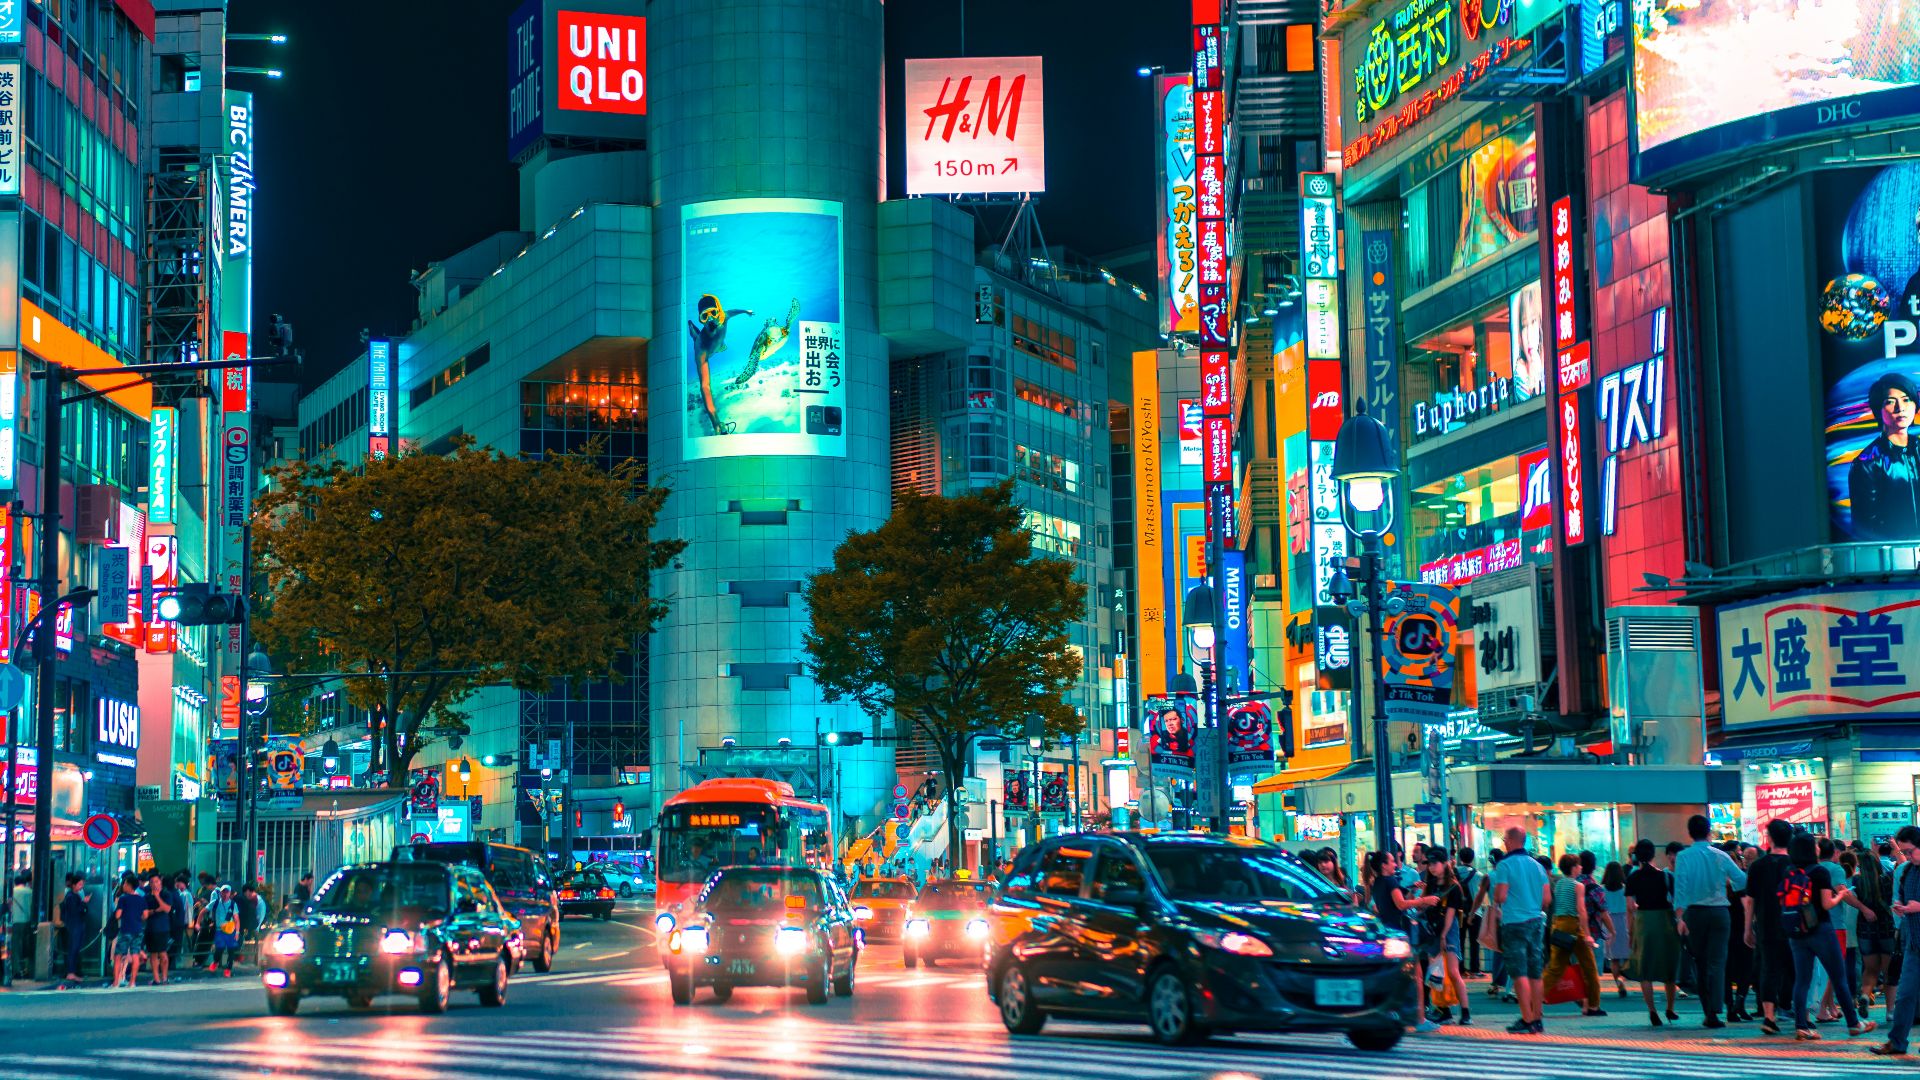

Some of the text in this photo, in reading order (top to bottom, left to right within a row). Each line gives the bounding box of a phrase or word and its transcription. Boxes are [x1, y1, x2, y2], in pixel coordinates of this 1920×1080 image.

[517, 15, 534, 77] THE
[570, 25, 636, 62] UNI
[1397, 1, 1451, 93] 西村
[511, 66, 540, 139] PRIME
[570, 65, 643, 105] QLO
[923, 74, 1026, 143] H&M
[1817, 100, 1861, 124] DHC
[230, 105, 256, 257] BIC CAMERA
[1205, 157, 1215, 165] 7F
[1206, 222, 1216, 230] 7F
[1207, 287, 1219, 295] 6F
[1317, 284, 1328, 344] Euphoria
[805, 336, 840, 351] 世界に
[1209, 355, 1220, 363] 6F
[1369, 289, 1394, 453] サマーフルー
[1313, 391, 1339, 410] JTB
[1415, 371, 1509, 435] Euphoria
[1600, 355, 1664, 453] クスリ
[1210, 421, 1222, 429] 6F
[1144, 456, 1154, 547] Matsumoto
[1316, 465, 1327, 503] パーラー
[111, 553, 125, 617] 渋谷駅前
[1319, 546, 1331, 587] フルーツ
[1226, 567, 1240, 629] MIZUHO
[151, 633, 165, 642] 3F
[1325, 625, 1349, 669] HUB
[1731, 612, 1907, 702] 大盛堂
[1399, 689, 1435, 702] Tik Tok
[100, 698, 139, 749] LUSH
[1742, 747, 1778, 758] TAISEIDO
